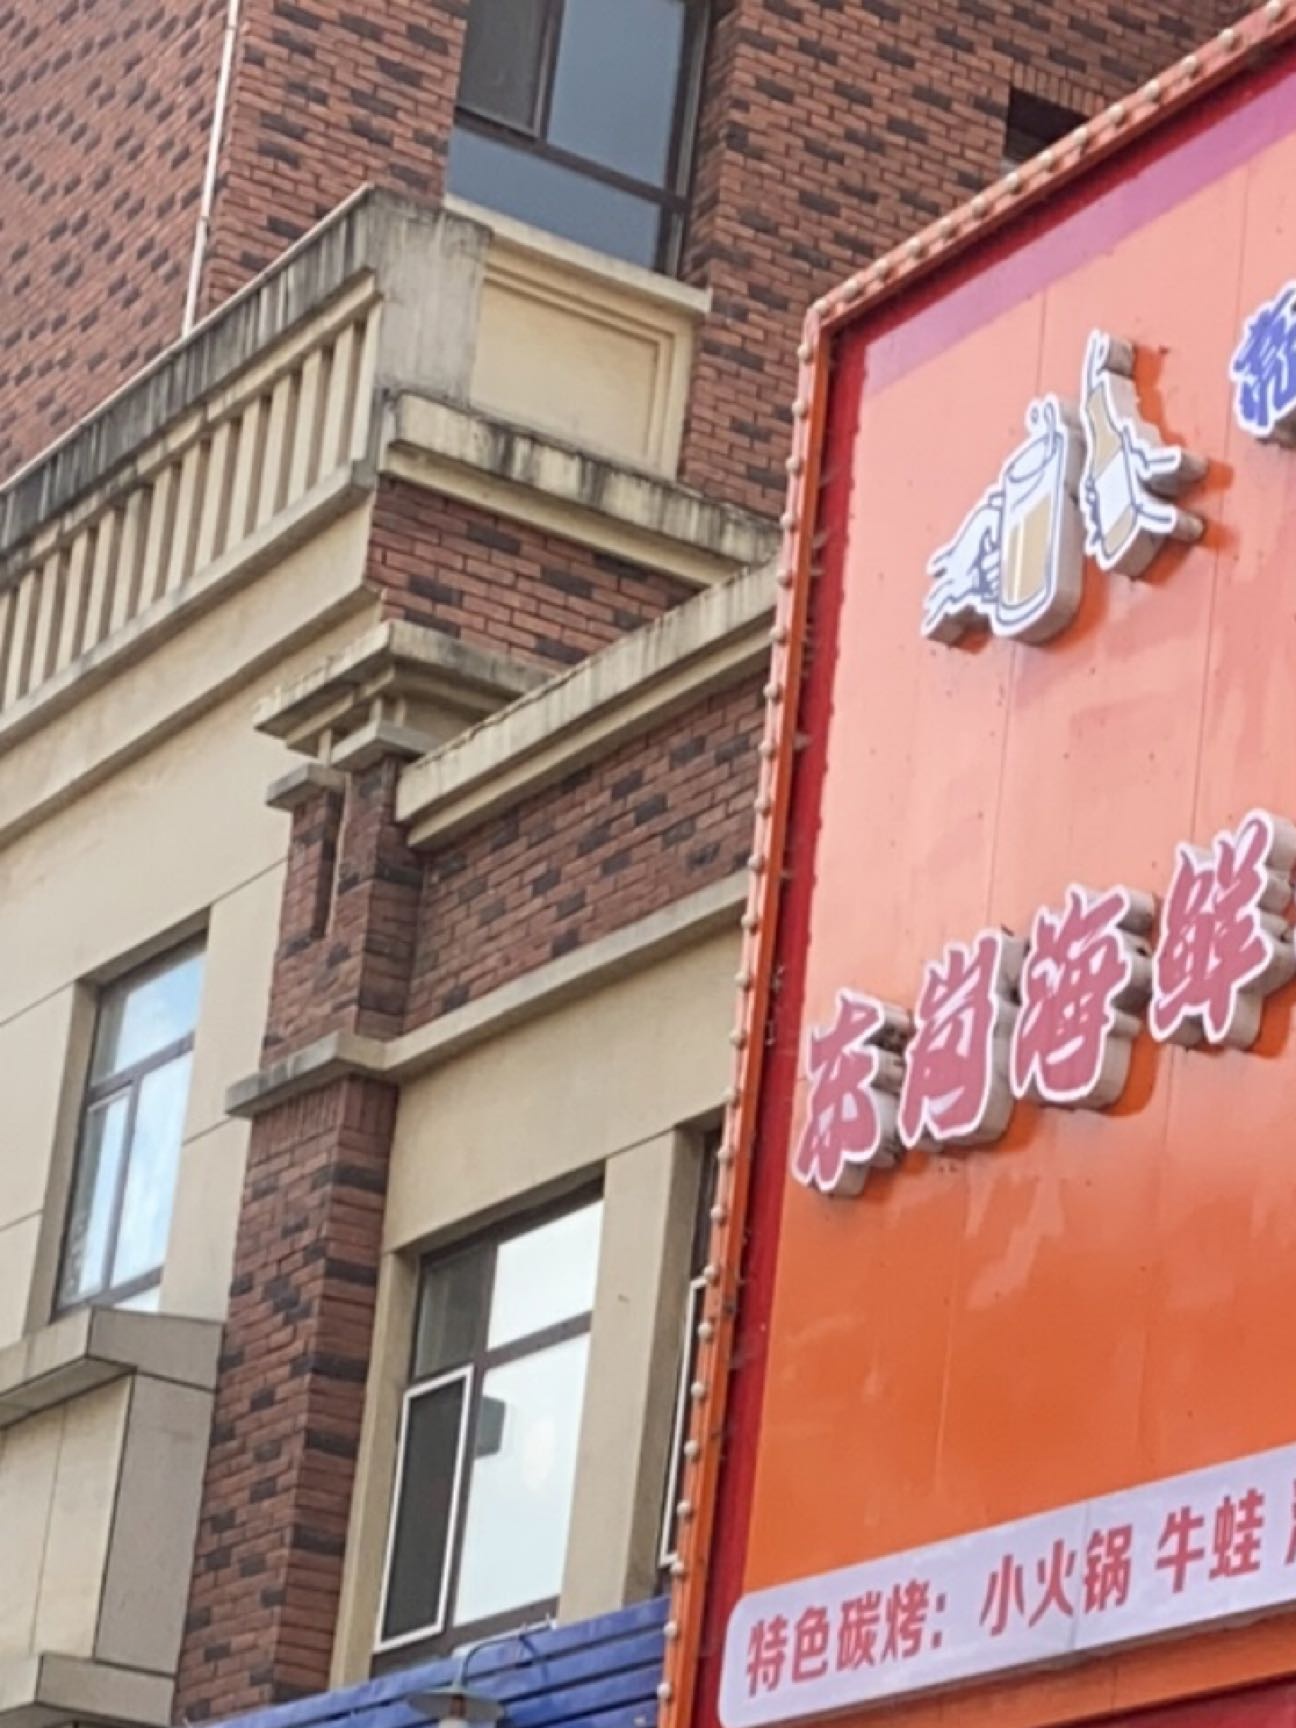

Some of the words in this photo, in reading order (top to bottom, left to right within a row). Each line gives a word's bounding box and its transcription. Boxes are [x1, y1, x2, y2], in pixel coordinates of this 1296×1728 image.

[978, 1522, 1134, 1638] 小火锅
[1151, 1486, 1267, 1595] 牛蛙
